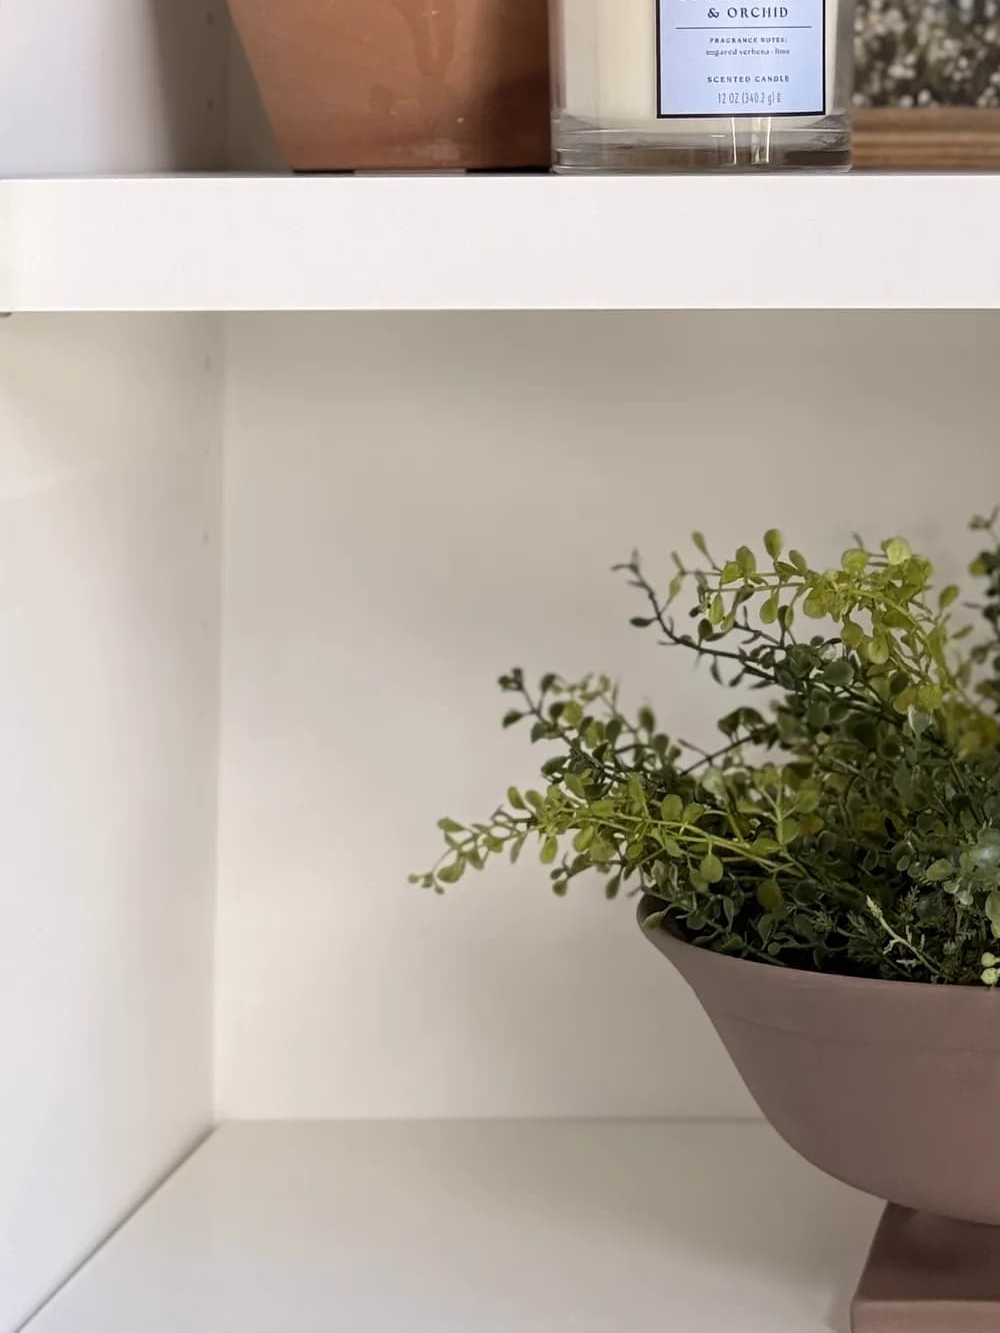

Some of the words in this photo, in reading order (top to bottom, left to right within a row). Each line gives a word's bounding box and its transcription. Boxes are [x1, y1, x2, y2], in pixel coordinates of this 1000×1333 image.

[707, 7, 720, 19] &
[727, 7, 788, 18] ORCHID
[739, 48, 770, 56] verbena
[718, 92, 727, 104] 12
[728, 92, 740, 103] OZ
[767, 92, 775, 105] g)
